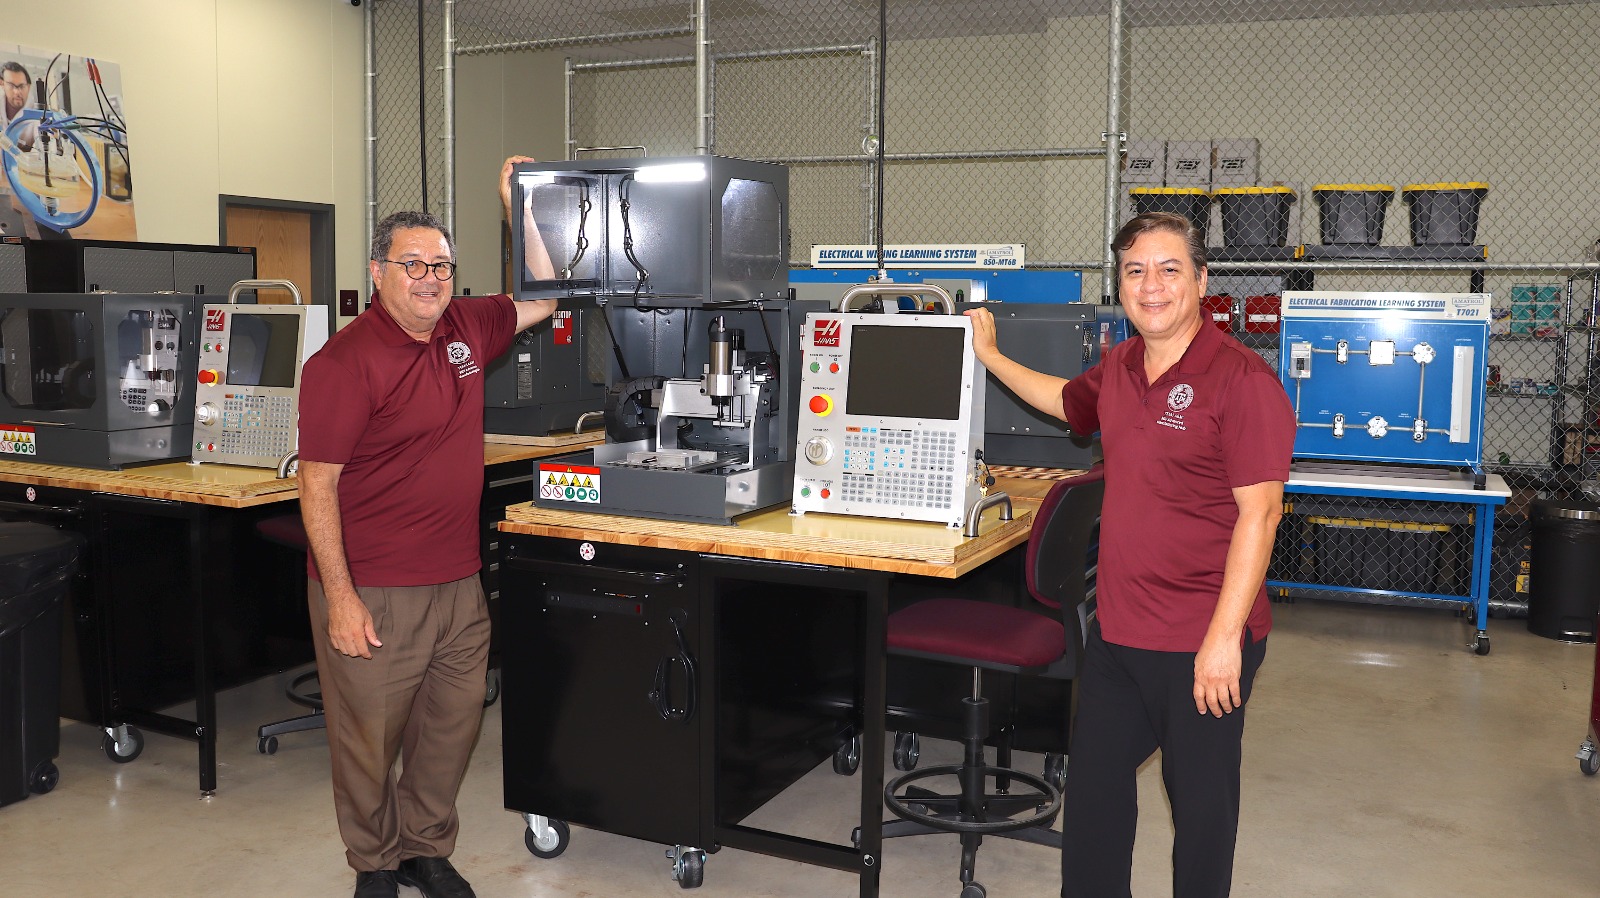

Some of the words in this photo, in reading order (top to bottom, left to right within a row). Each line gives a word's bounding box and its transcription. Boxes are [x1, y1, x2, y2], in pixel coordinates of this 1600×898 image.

[819, 249, 863, 258] ELECTRICAL
[866, 249, 898, 258] WIING
[900, 249, 942, 258] LEARNING
[944, 249, 977, 258] SYSTEM
[983, 258, 1016, 266] 850-MT6B
[1289, 298, 1328, 306] ELECTRICAL
[1379, 299, 1415, 307] LEARNING
[1417, 300, 1446, 308] SYSTEM
[1457, 308, 1479, 316] T7021
[814, 337, 840, 345] HAAS
